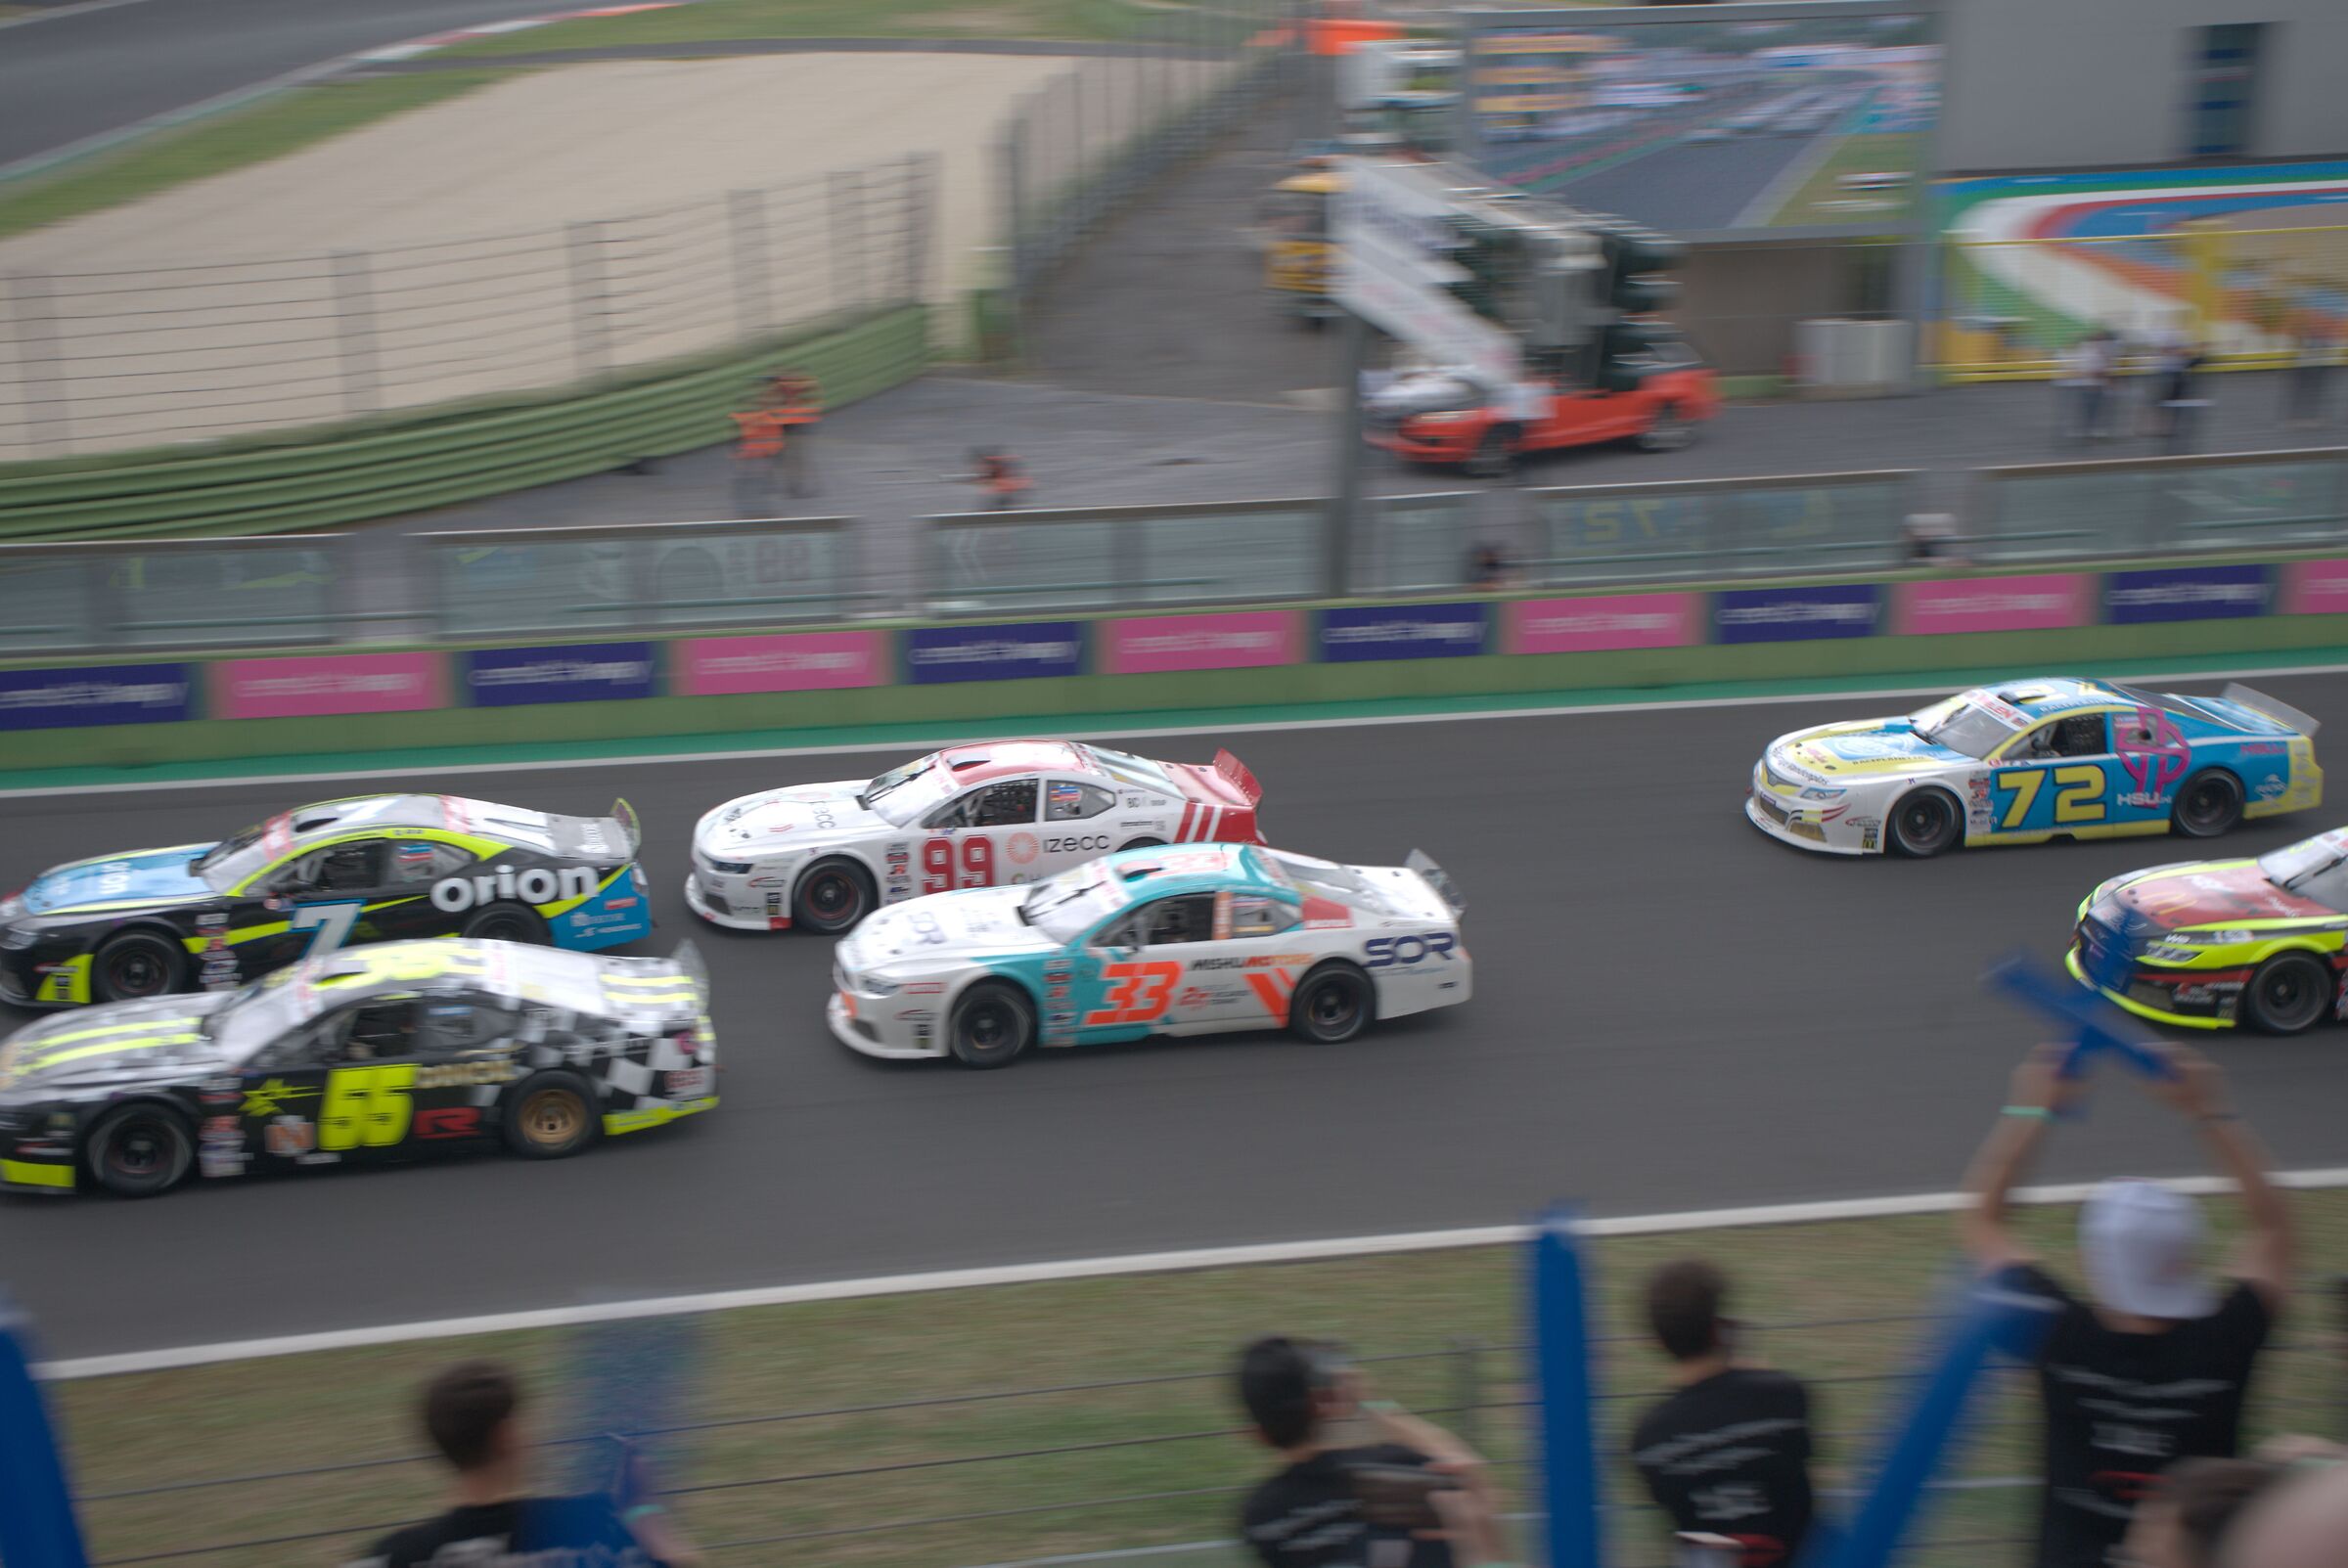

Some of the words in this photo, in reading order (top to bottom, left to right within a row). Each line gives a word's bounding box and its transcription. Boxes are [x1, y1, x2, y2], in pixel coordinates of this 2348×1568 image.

[1999, 765, 2105, 829] 72
[921, 833, 994, 894] 99
[1043, 833, 1109, 853] izecc
[430, 864, 600, 913] orion
[291, 900, 368, 961] 7
[1364, 932, 1455, 967] SOR
[1084, 961, 1180, 1025] 33
[317, 1064, 422, 1150] 55
